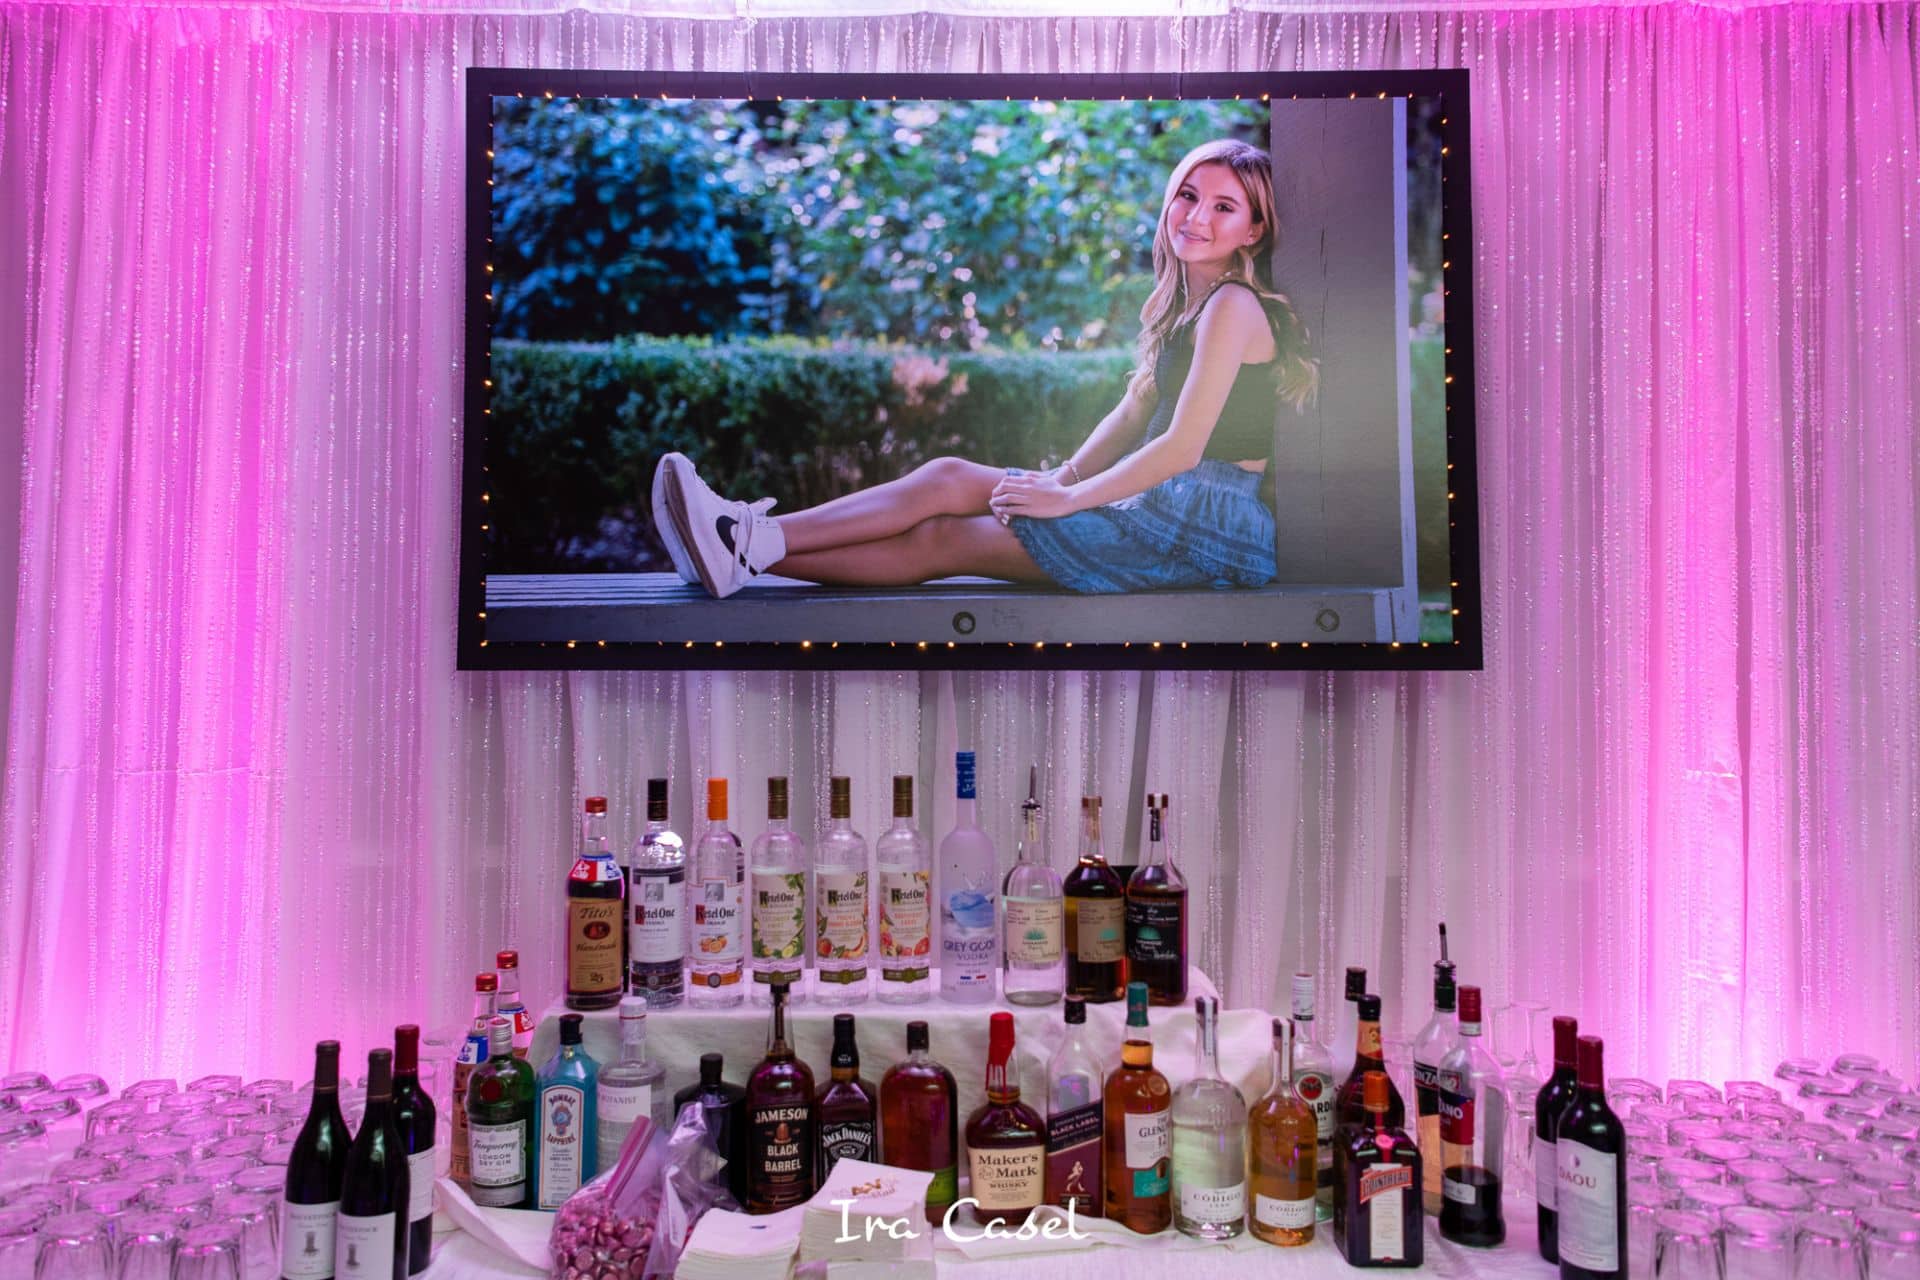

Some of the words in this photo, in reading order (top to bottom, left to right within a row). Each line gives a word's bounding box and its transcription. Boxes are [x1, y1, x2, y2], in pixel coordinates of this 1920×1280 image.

[579, 905, 616, 919] Tito's
[549, 1094, 577, 1106] BOMBAY
[755, 1108, 809, 1124] JAMESON
[1050, 1124, 1075, 1137] BLACK
[546, 1133, 577, 1145] SAPPHIRE
[822, 1131, 842, 1148] JACK
[767, 1143, 799, 1157] BLACK
[479, 1153, 512, 1161] LONDON
[978, 1153, 1039, 1166] Maker's
[764, 1158, 803, 1173] BARREL
[995, 1166, 1038, 1178] Mark
[1558, 1166, 1598, 1190] DAOU
